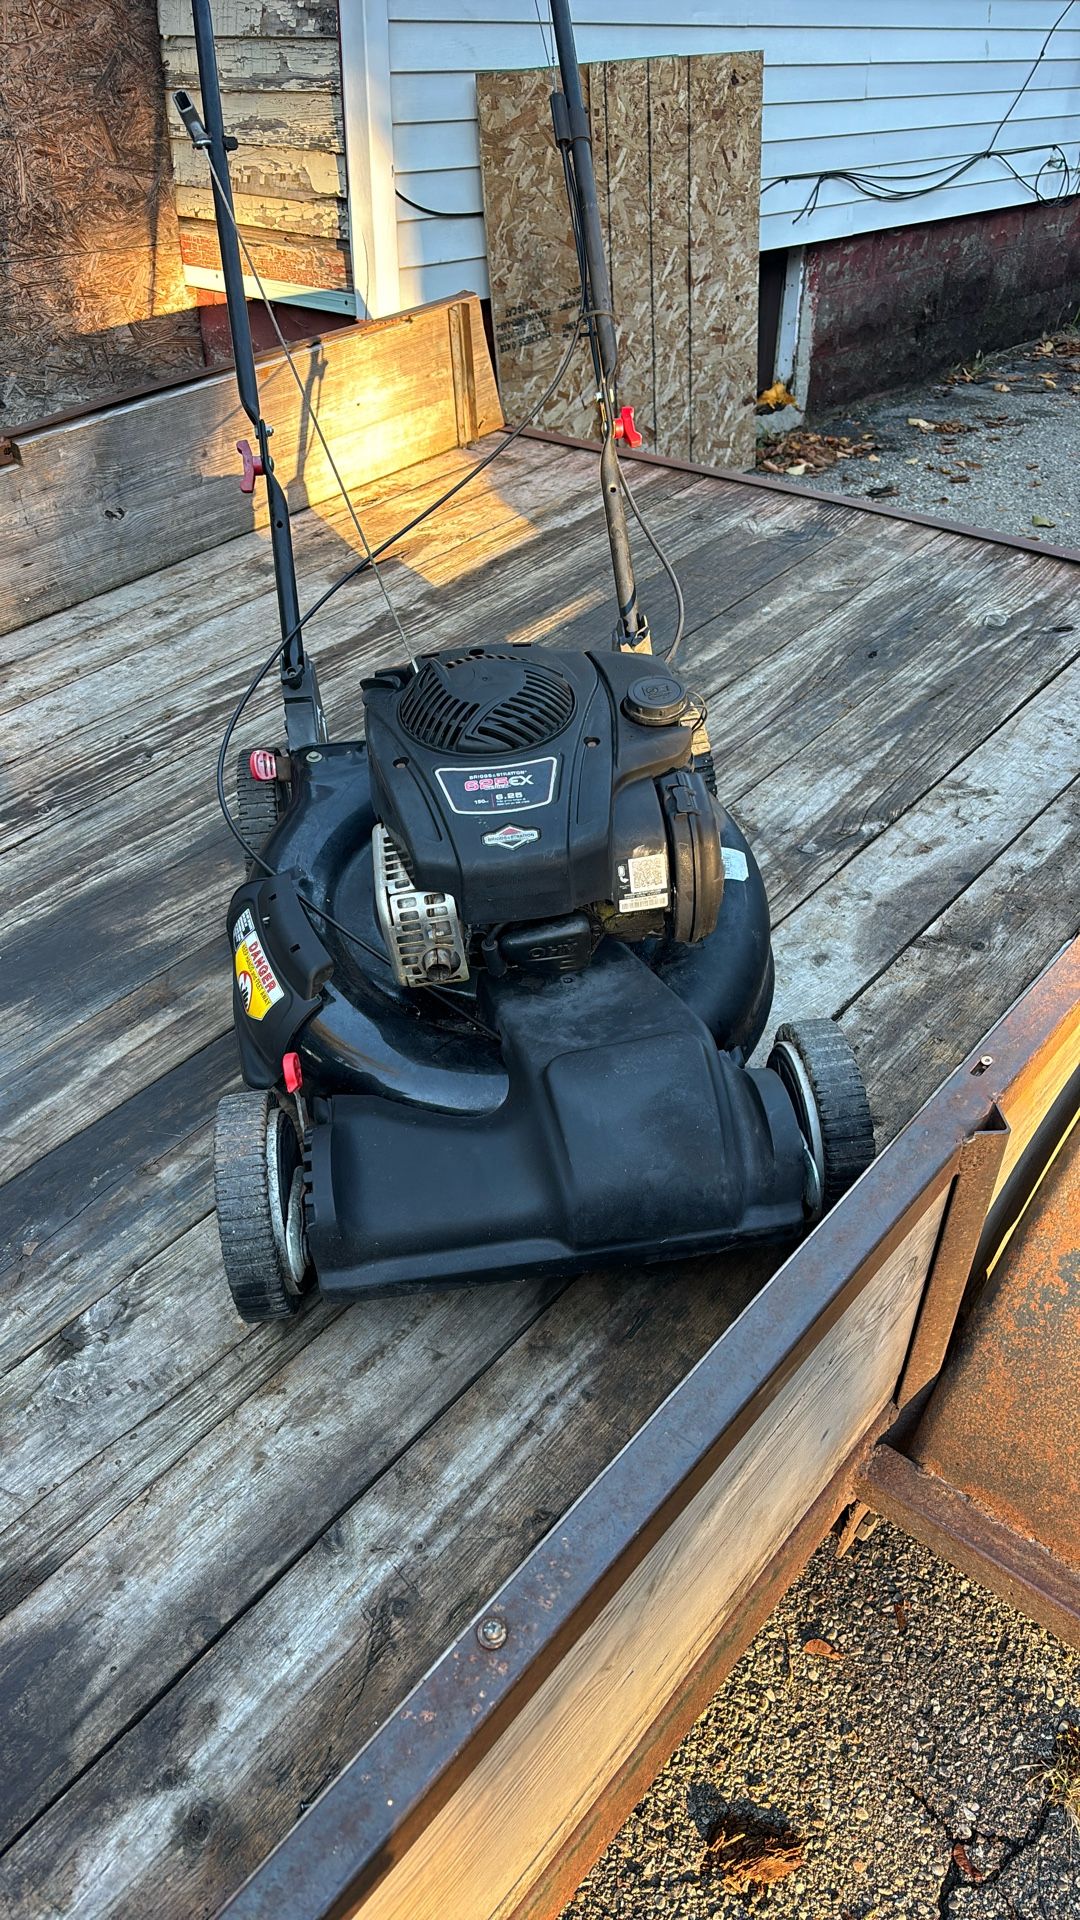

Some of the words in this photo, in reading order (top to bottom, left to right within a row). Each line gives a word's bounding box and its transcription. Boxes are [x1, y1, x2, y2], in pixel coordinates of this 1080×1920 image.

[496, 792, 523, 800] 6.25
[248, 940, 277, 994] DANGER
[254, 978, 264, 992] FEET
[260, 990, 271, 1006] AWAY
